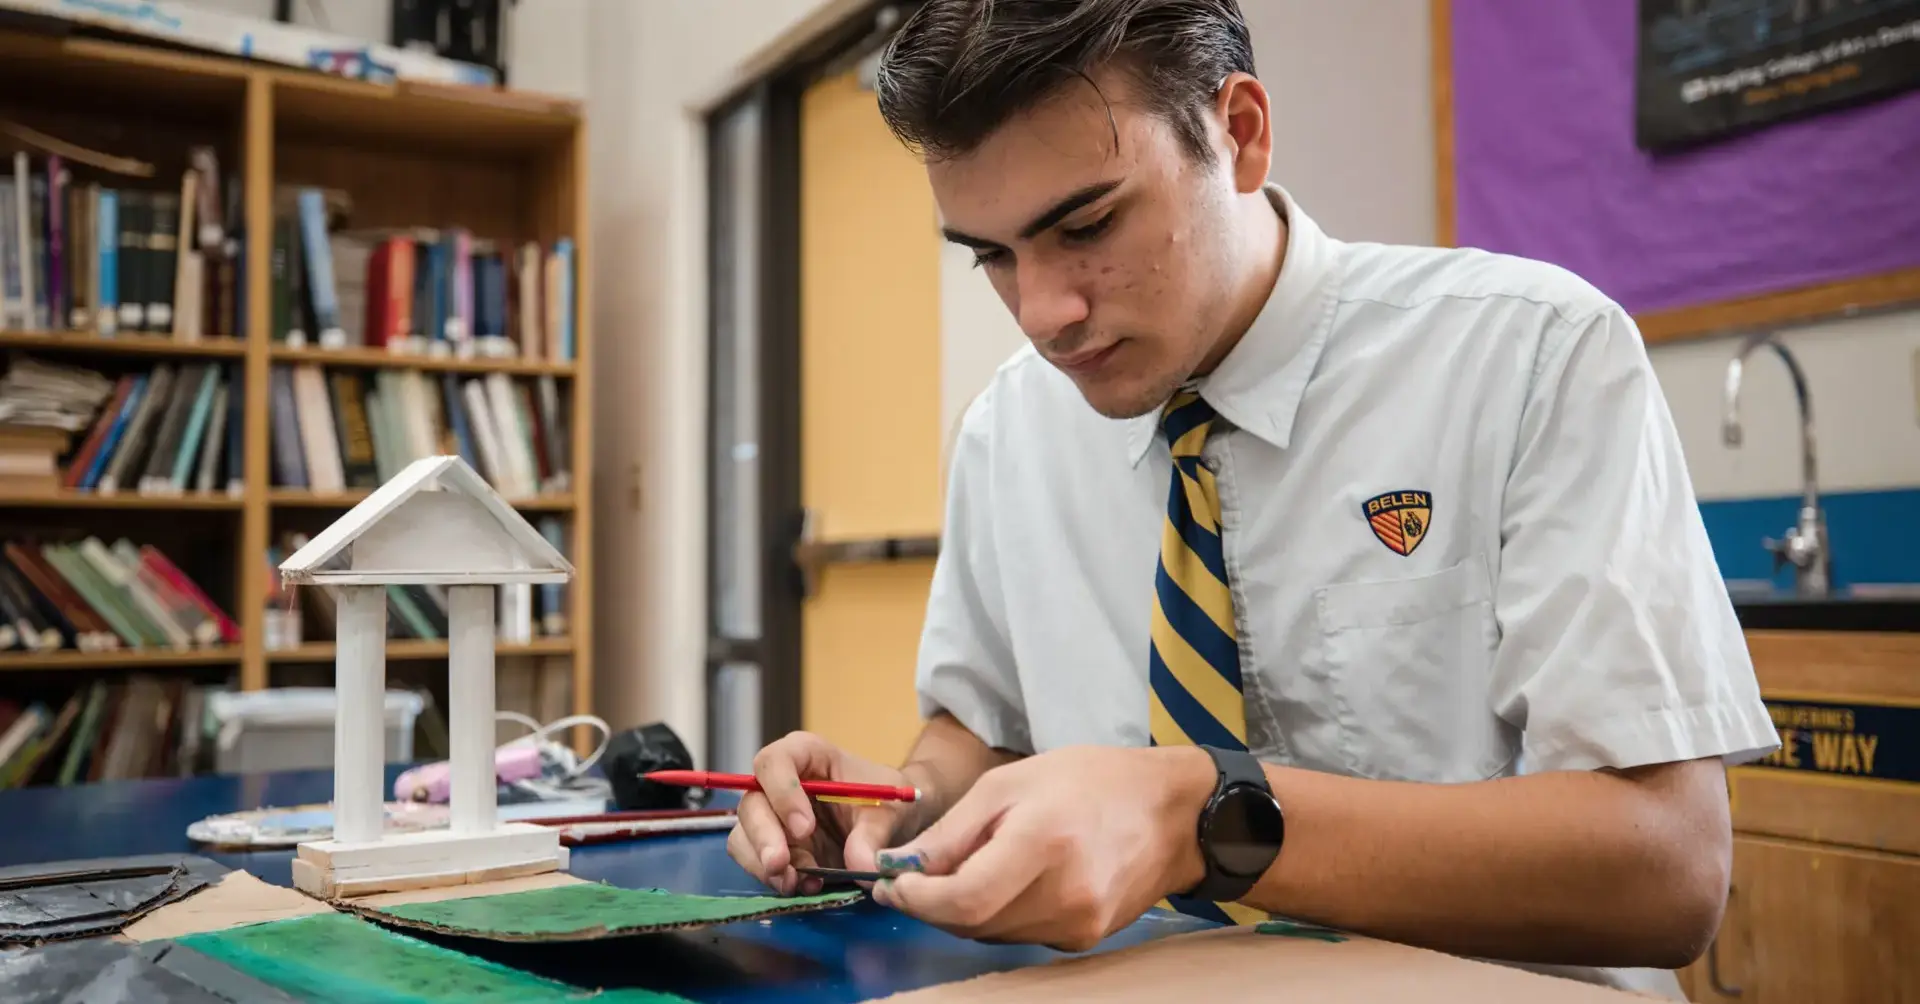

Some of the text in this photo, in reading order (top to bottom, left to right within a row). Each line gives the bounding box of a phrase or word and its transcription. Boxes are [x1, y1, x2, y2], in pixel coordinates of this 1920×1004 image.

[1367, 493, 1427, 514] BELEN
[1767, 704, 1856, 731] OLVERINES
[1812, 731, 1878, 774] WAY
